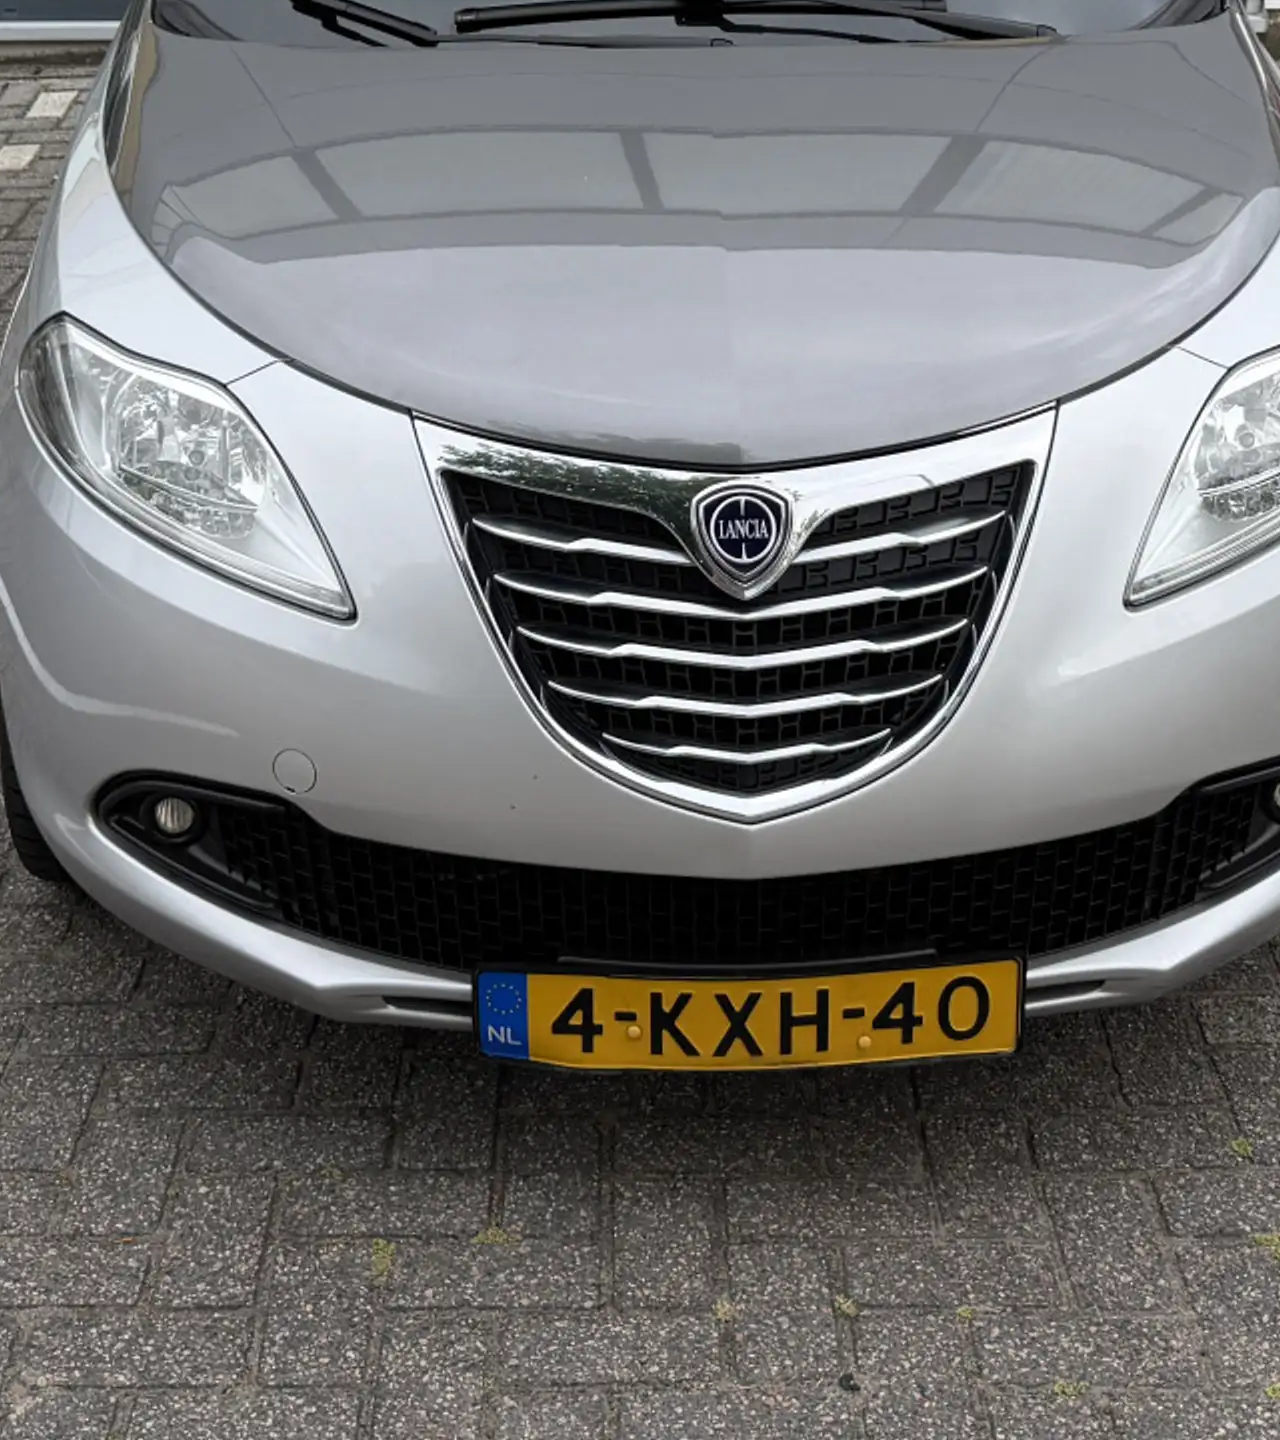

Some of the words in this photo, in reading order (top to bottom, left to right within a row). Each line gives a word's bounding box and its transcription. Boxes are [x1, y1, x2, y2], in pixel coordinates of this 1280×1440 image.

[718, 518, 769, 539] LANCIA
[551, 975, 990, 1058] 4-KXH-40
[487, 1024, 522, 1046] NL
